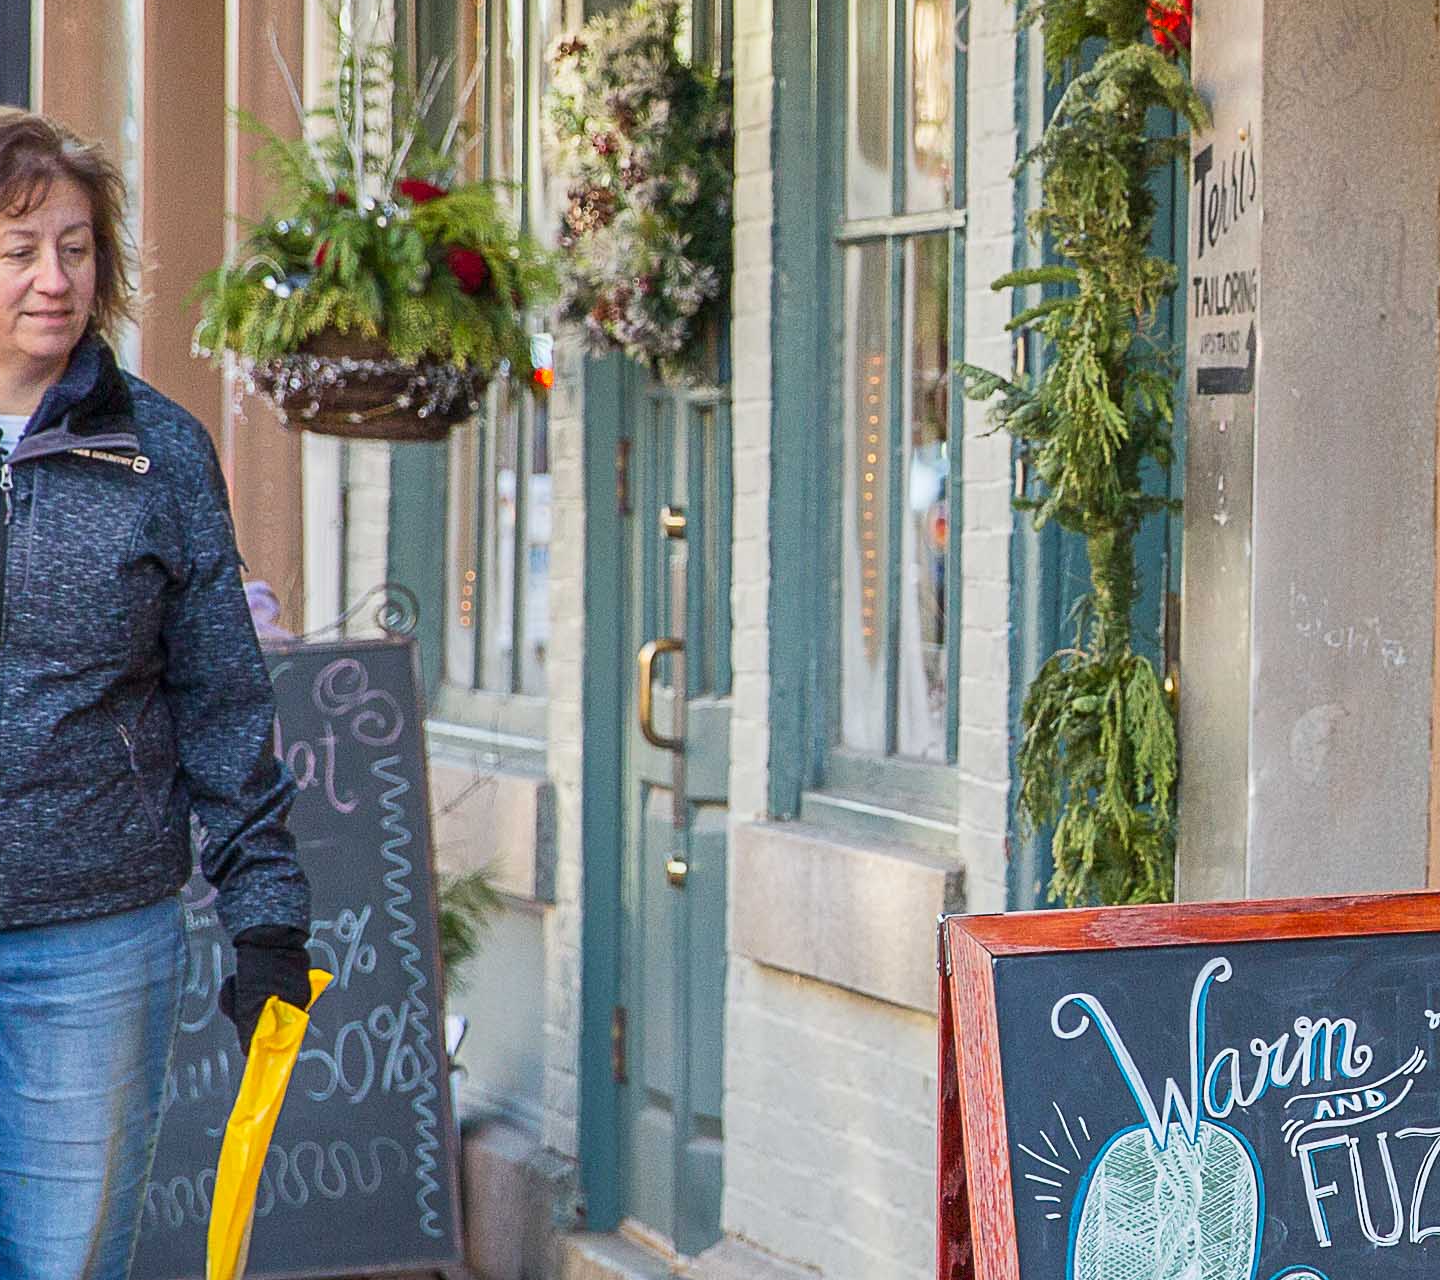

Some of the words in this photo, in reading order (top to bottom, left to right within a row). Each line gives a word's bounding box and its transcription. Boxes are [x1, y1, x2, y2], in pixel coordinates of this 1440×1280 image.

[1193, 267, 1257, 319] TAILORING
[1199, 331, 1241, 356] UPSTAIRS
[1051, 956, 1374, 1152] Warm
[1312, 1087, 1387, 1121] AND
